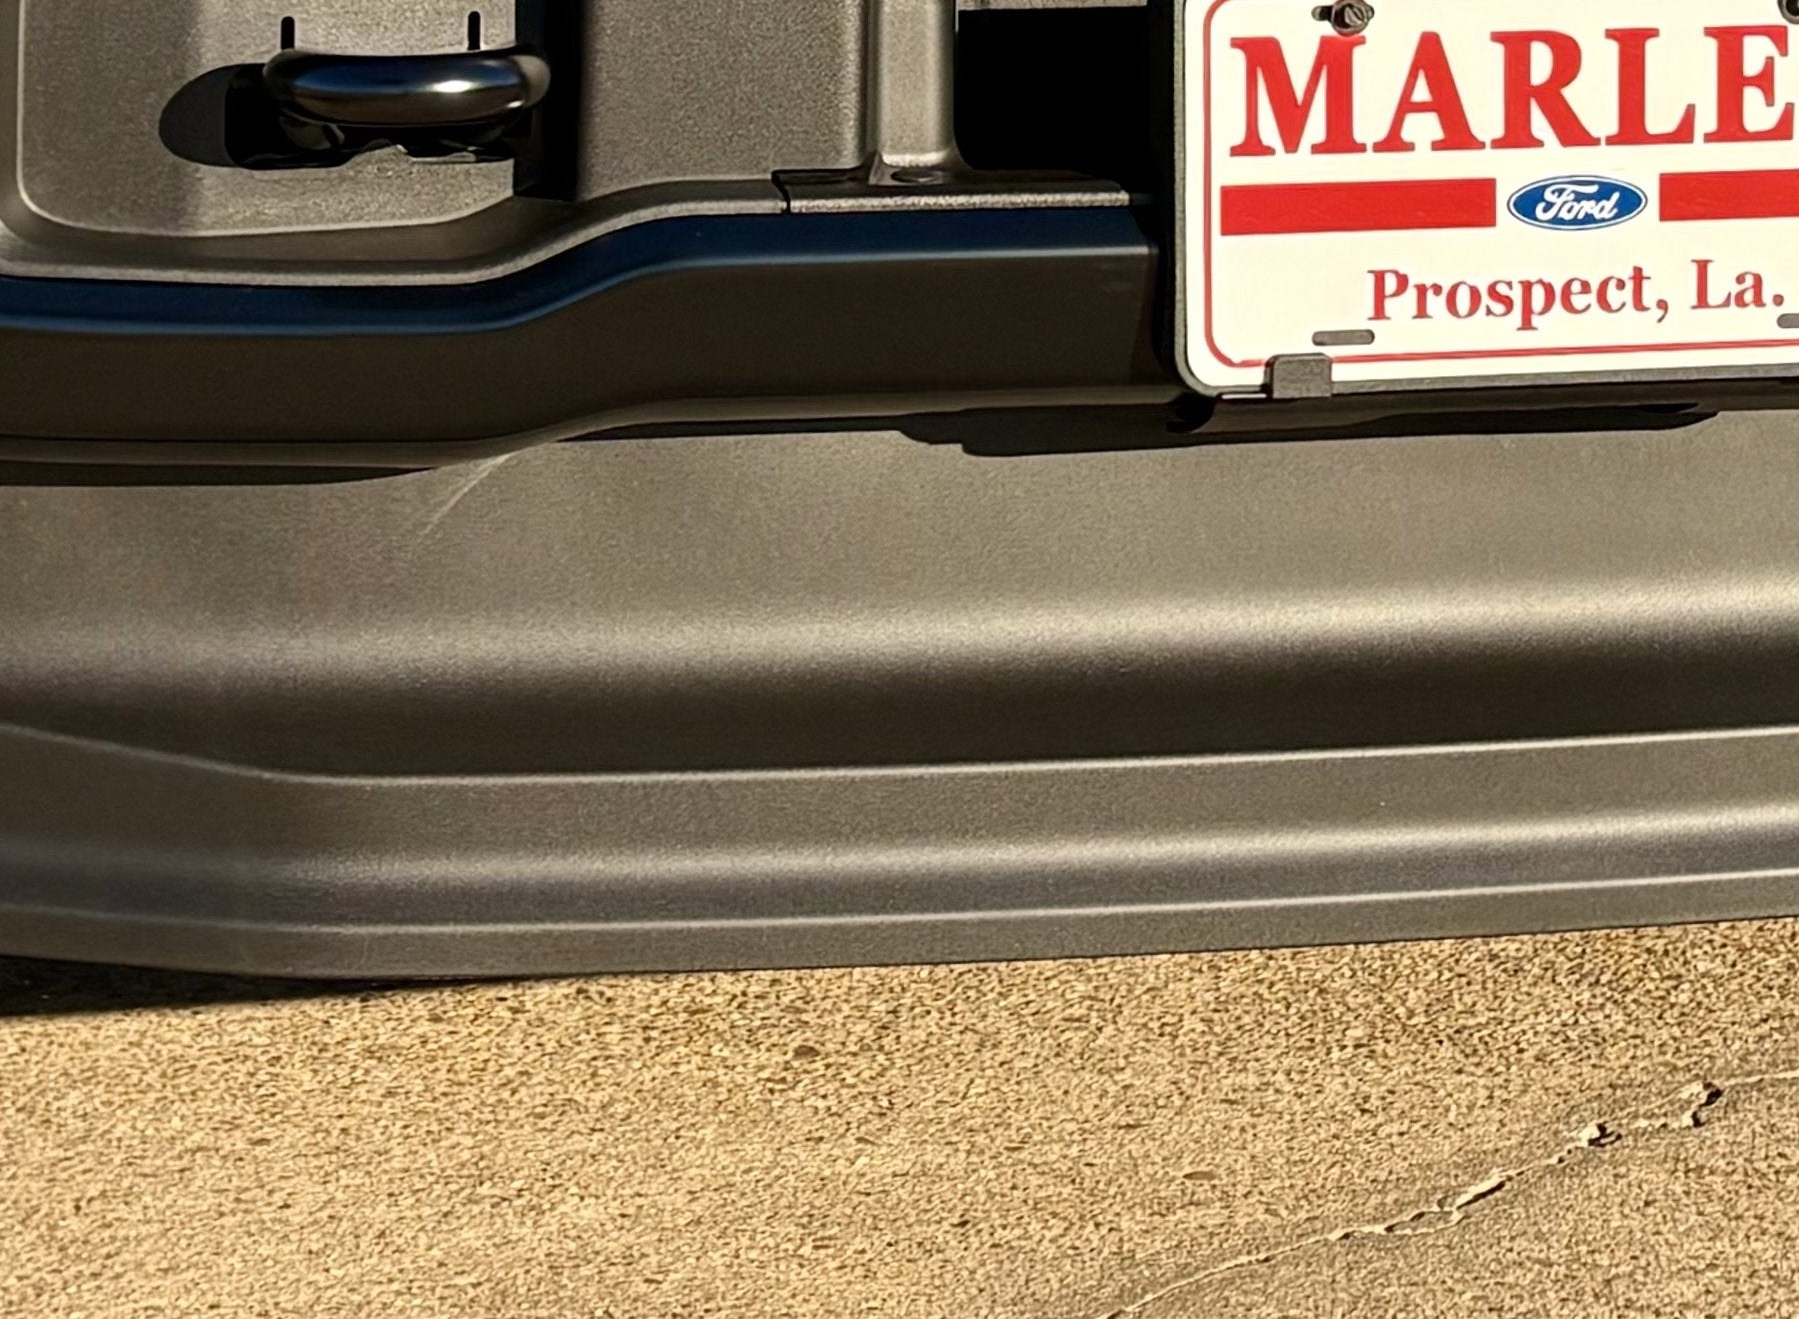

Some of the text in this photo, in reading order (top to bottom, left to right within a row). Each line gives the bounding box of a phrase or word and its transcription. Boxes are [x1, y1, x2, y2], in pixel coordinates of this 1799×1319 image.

[1534, 185, 1621, 222] Ford
[1366, 259, 1785, 333] Prospect, La.
